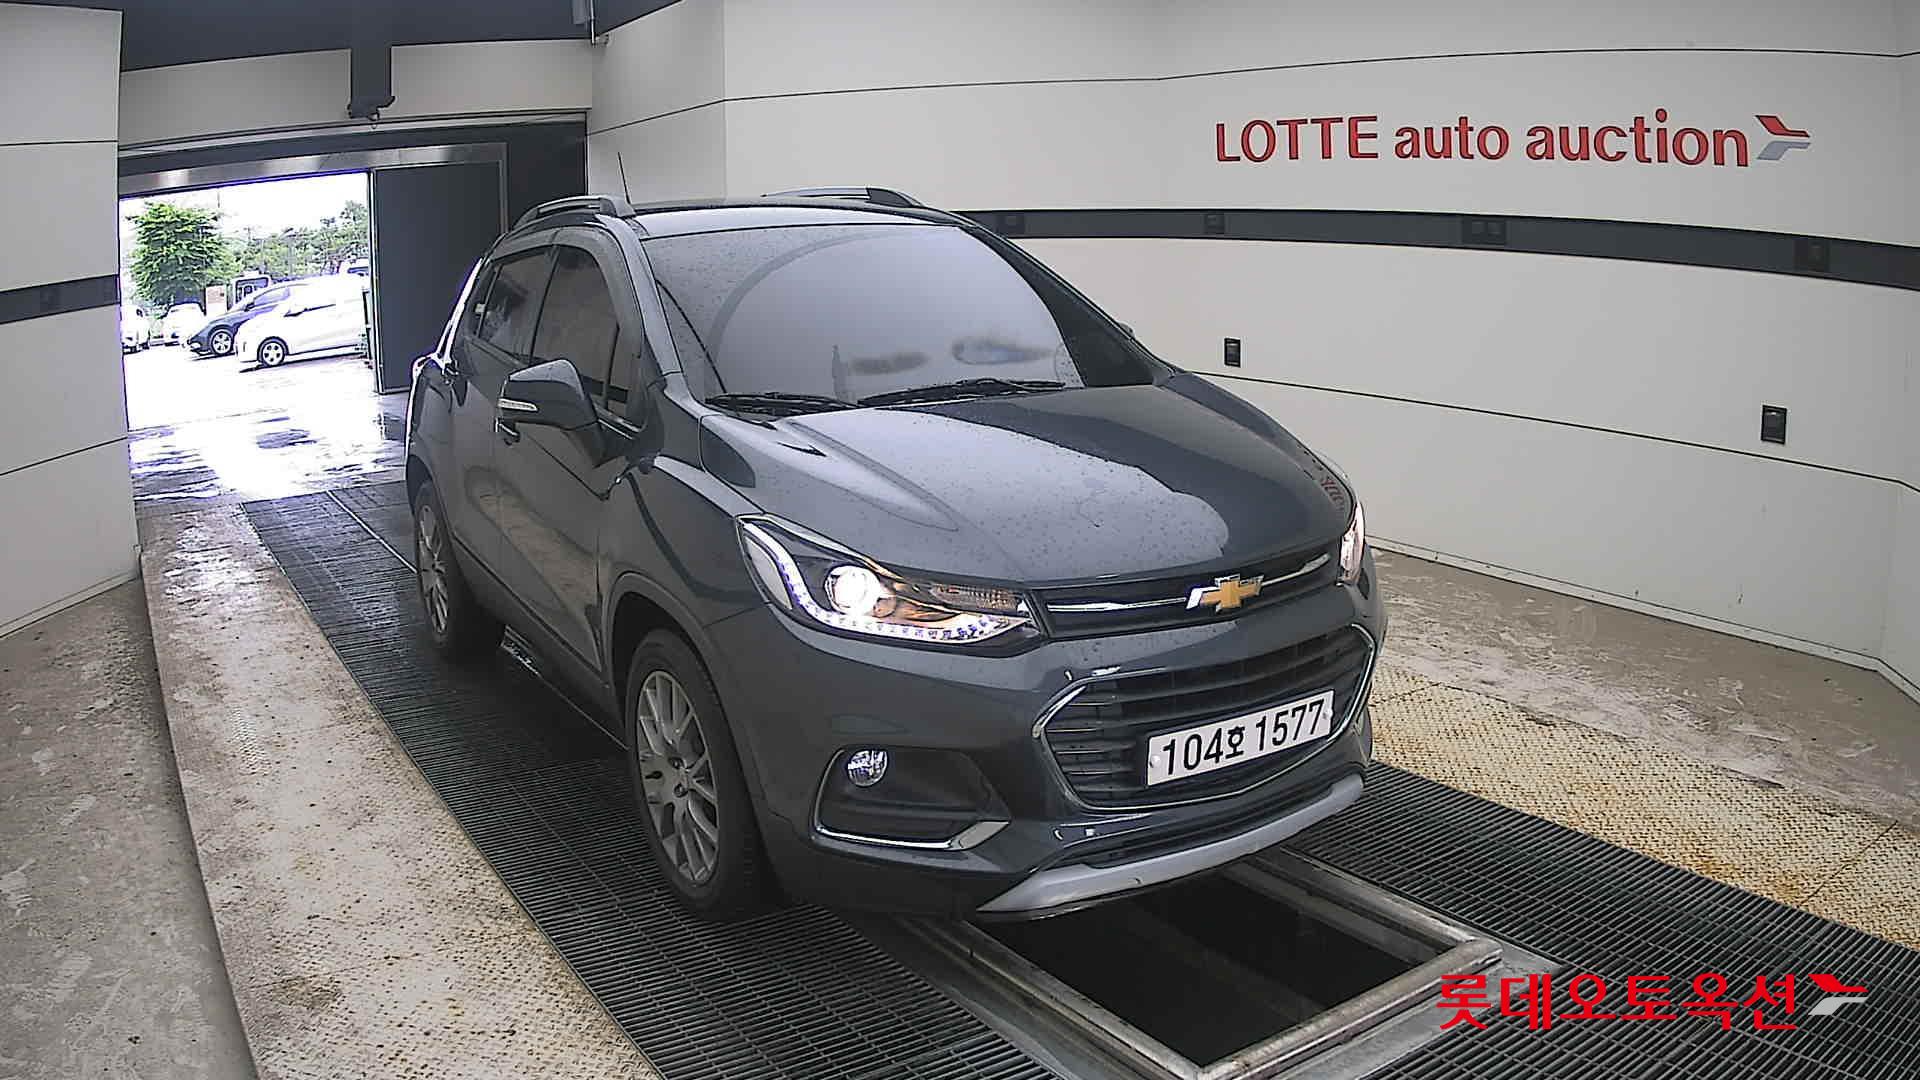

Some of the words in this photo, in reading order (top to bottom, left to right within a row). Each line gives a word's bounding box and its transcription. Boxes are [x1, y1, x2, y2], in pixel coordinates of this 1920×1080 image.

[1216, 116, 1378, 162] LOTTE
[1394, 116, 1509, 160] auto
[1525, 108, 1749, 167] auction
[1162, 725, 1246, 776] 104호
[1255, 698, 1325, 752] 1577
